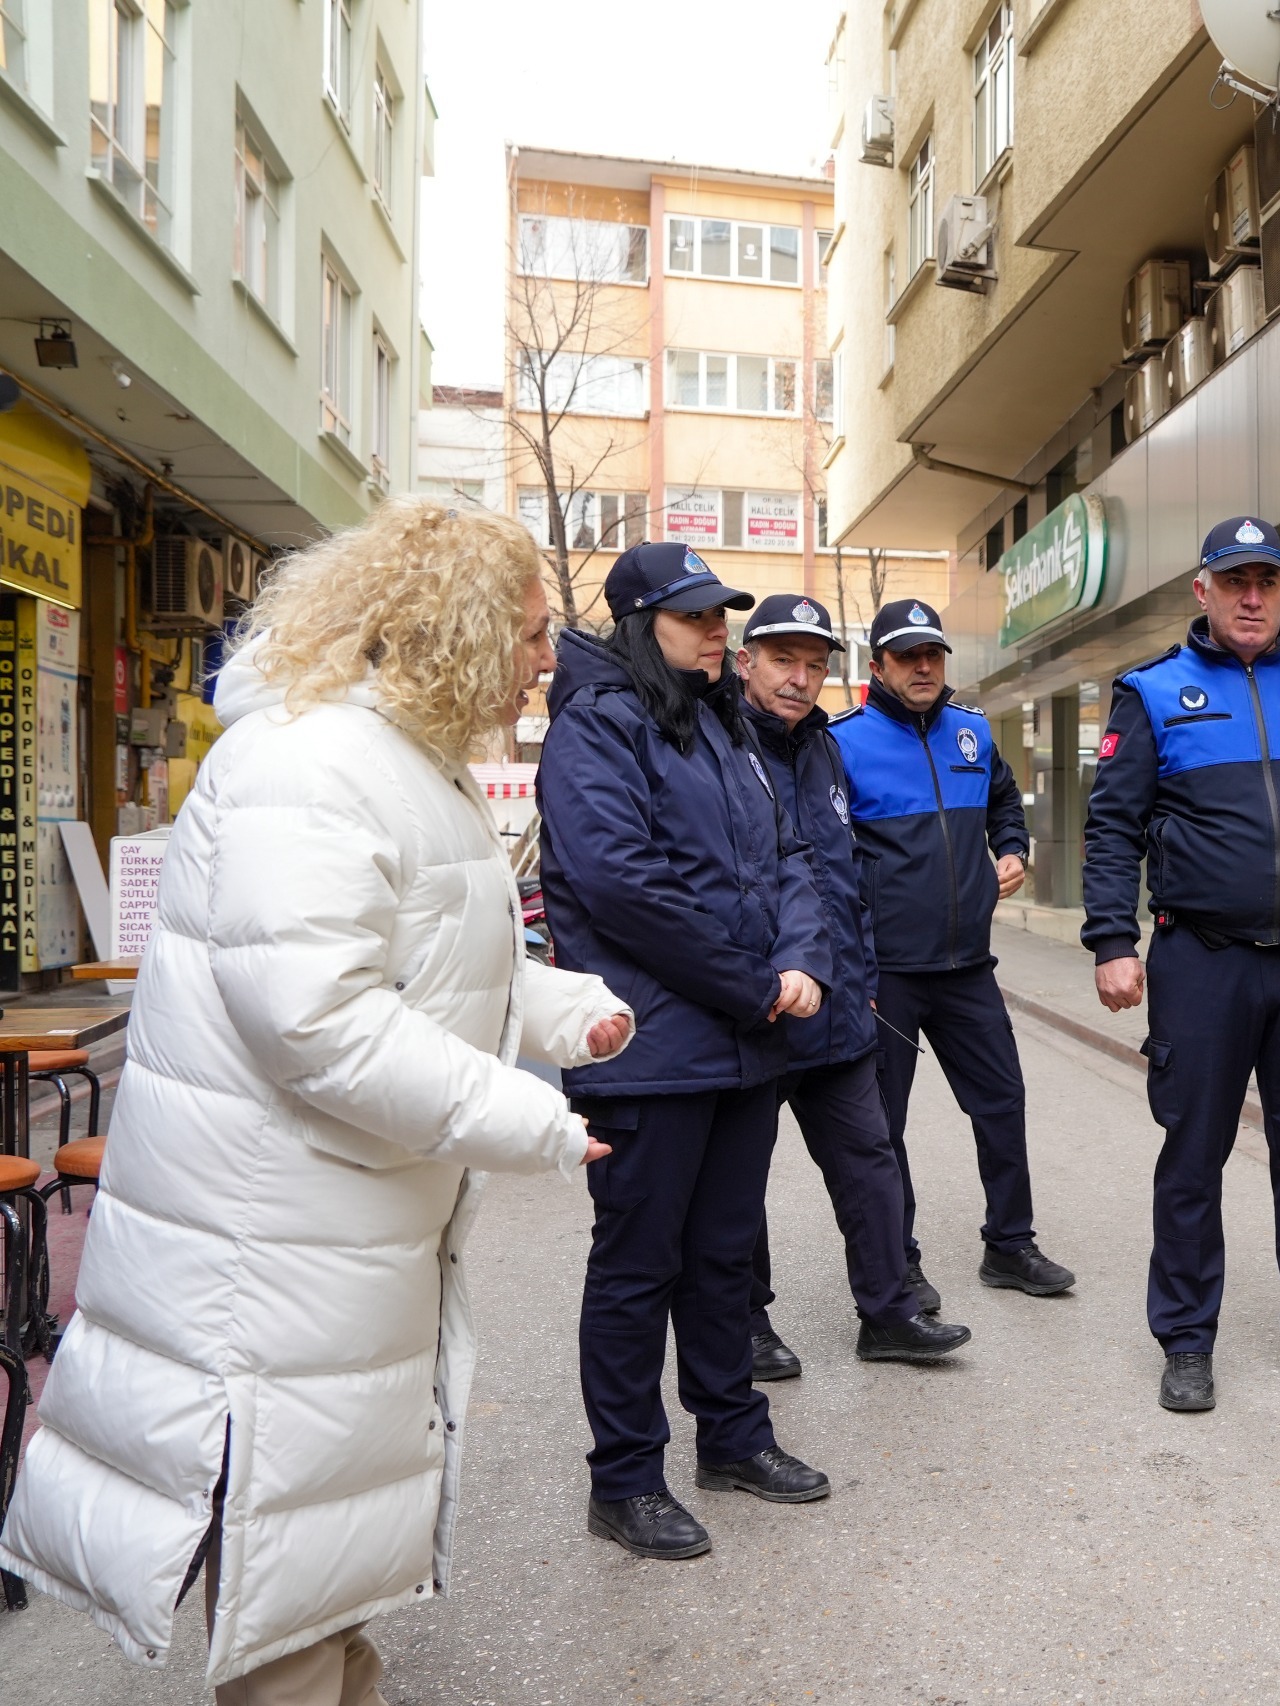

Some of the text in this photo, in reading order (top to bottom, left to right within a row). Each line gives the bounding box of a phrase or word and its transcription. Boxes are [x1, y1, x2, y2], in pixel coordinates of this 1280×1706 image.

[0, 481, 75, 545] PEDİ
[694, 503, 715, 513] ÇELİK
[751, 506, 795, 517] HALİL ÇELİK
[669, 516, 690, 525] KADIN
[750, 520, 770, 529] KADIN
[0, 659, 15, 796] ORTOPEDİ
[1, 807, 15, 821] &
[21, 668, 35, 957] ORTOPEDİ & MEDİKAL
[121, 845, 142, 857] ÇAY
[120, 855, 149, 865] TÜRK
[120, 868, 161, 876] ESPRES
[120, 878, 149, 887] SADE
[1, 832, 17, 951] MEDİKAL
[120, 888, 154, 898] SÜTLÜ
[120, 900, 159, 909] CAPPU
[120, 911, 150, 920] LATTE
[120, 922, 152, 931] SICAK
[118, 945, 140, 953] TAZE
